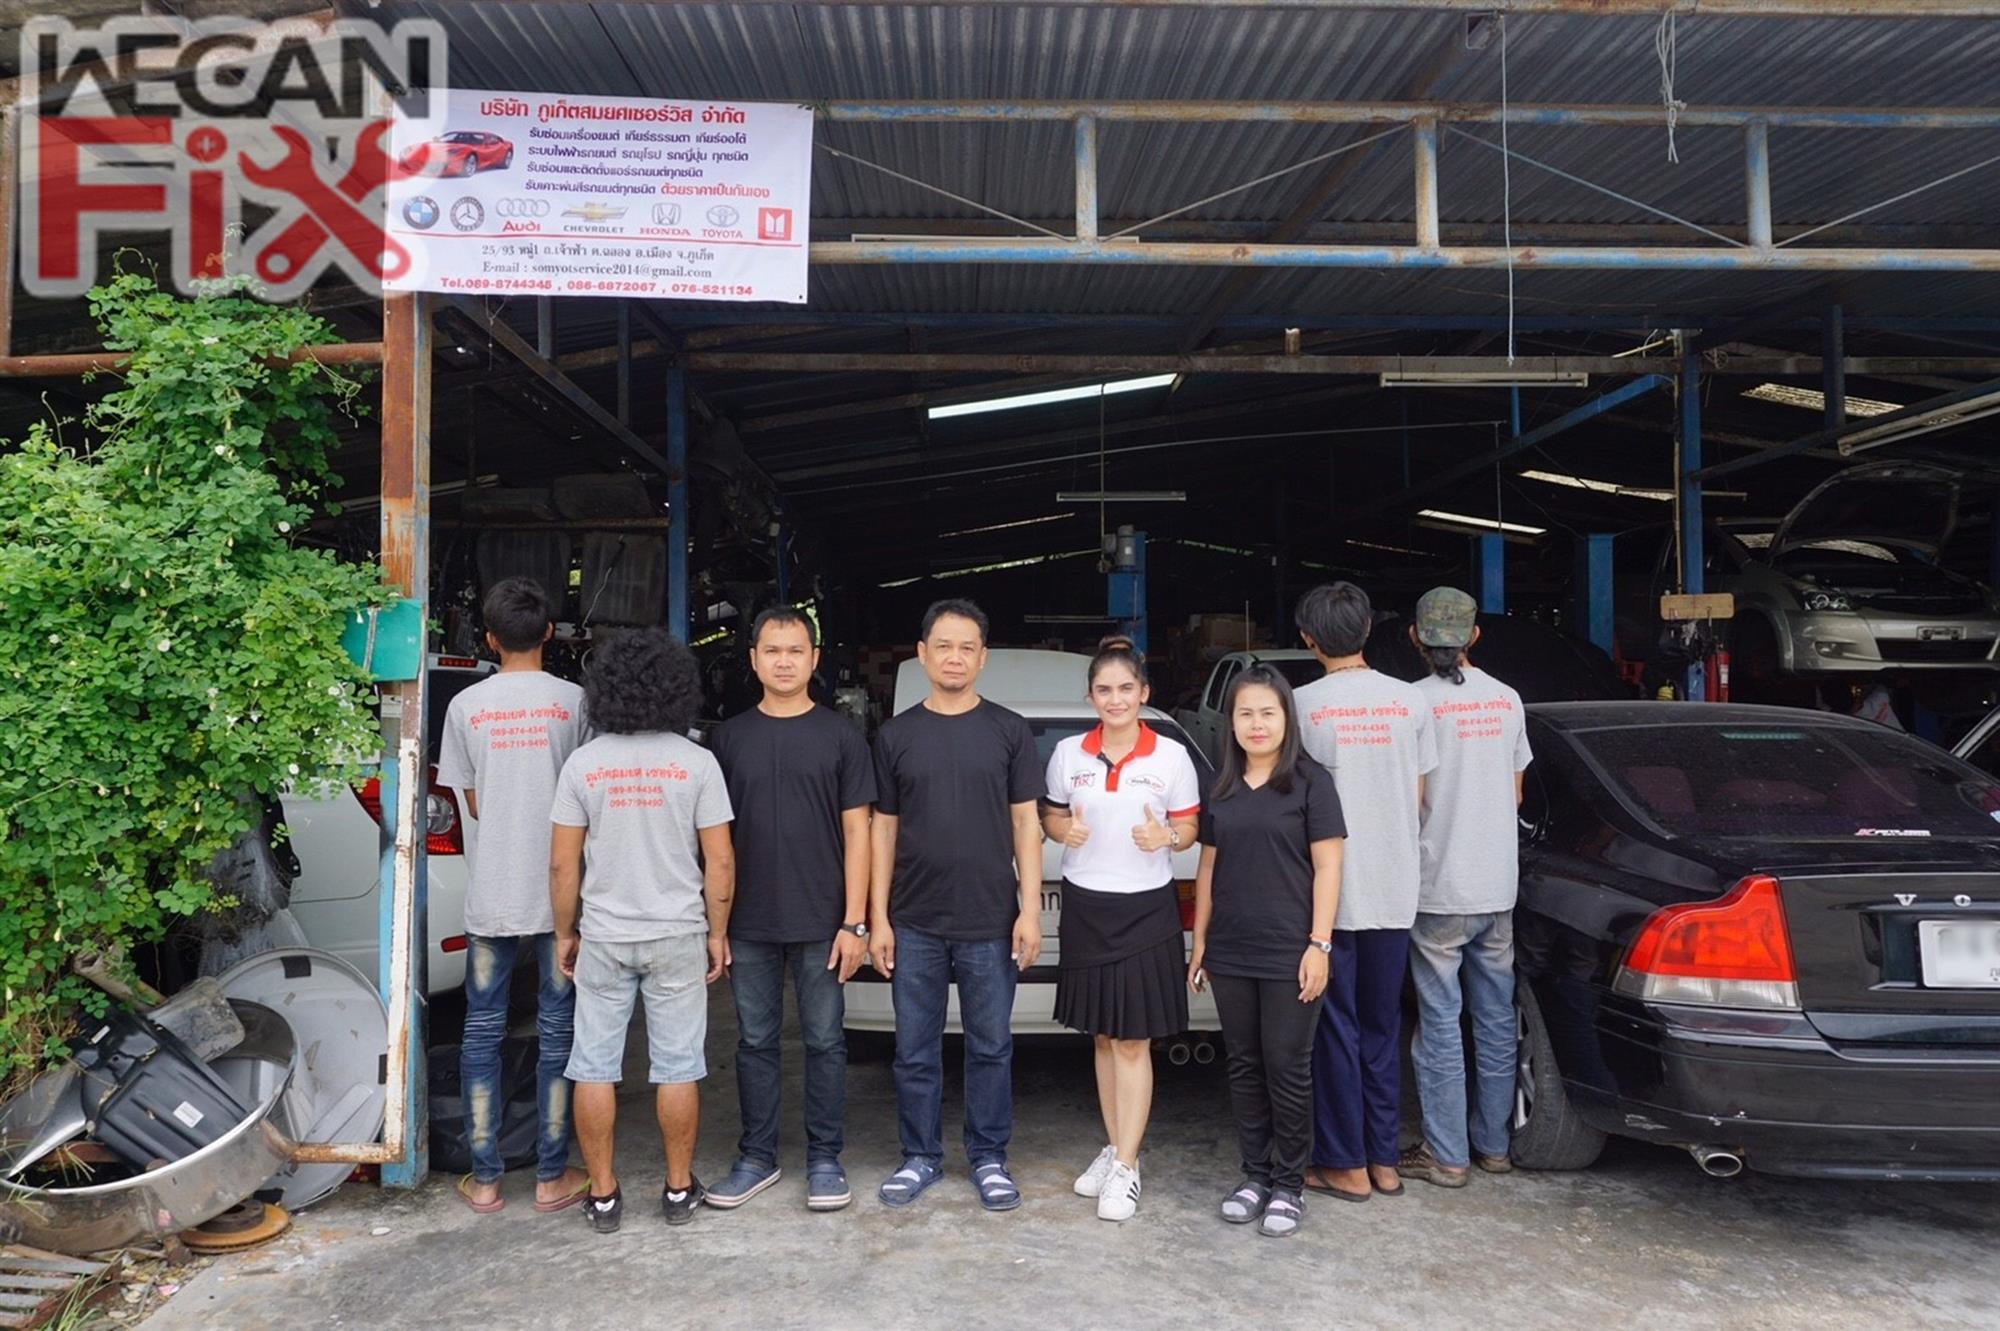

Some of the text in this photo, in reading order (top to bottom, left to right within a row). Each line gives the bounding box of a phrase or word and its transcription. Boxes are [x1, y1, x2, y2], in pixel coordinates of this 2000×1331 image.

[480, 97, 529, 117] บริษัท
[701, 106, 745, 124] จำกัด
[529, 126, 620, 141] รับซ่อมเครื่องยนต์
[624, 129, 690, 143] เกียร์ธรรมดา
[621, 147, 662, 162] รถยุโรป
[666, 148, 708, 164] รถญี่ปุ่น
[712, 151, 749, 164] ทุกชนิด
[661, 182, 770, 198] ด้วยราคาเป็นกันเอง
[563, 225, 624, 234] CHEVROLET
[639, 228, 691, 236] HONDA
[701, 229, 744, 239] TOYOTA
[482, 261, 520, 273] E-mail
[531, 261, 713, 279] somyotservice2014@gmail.com
